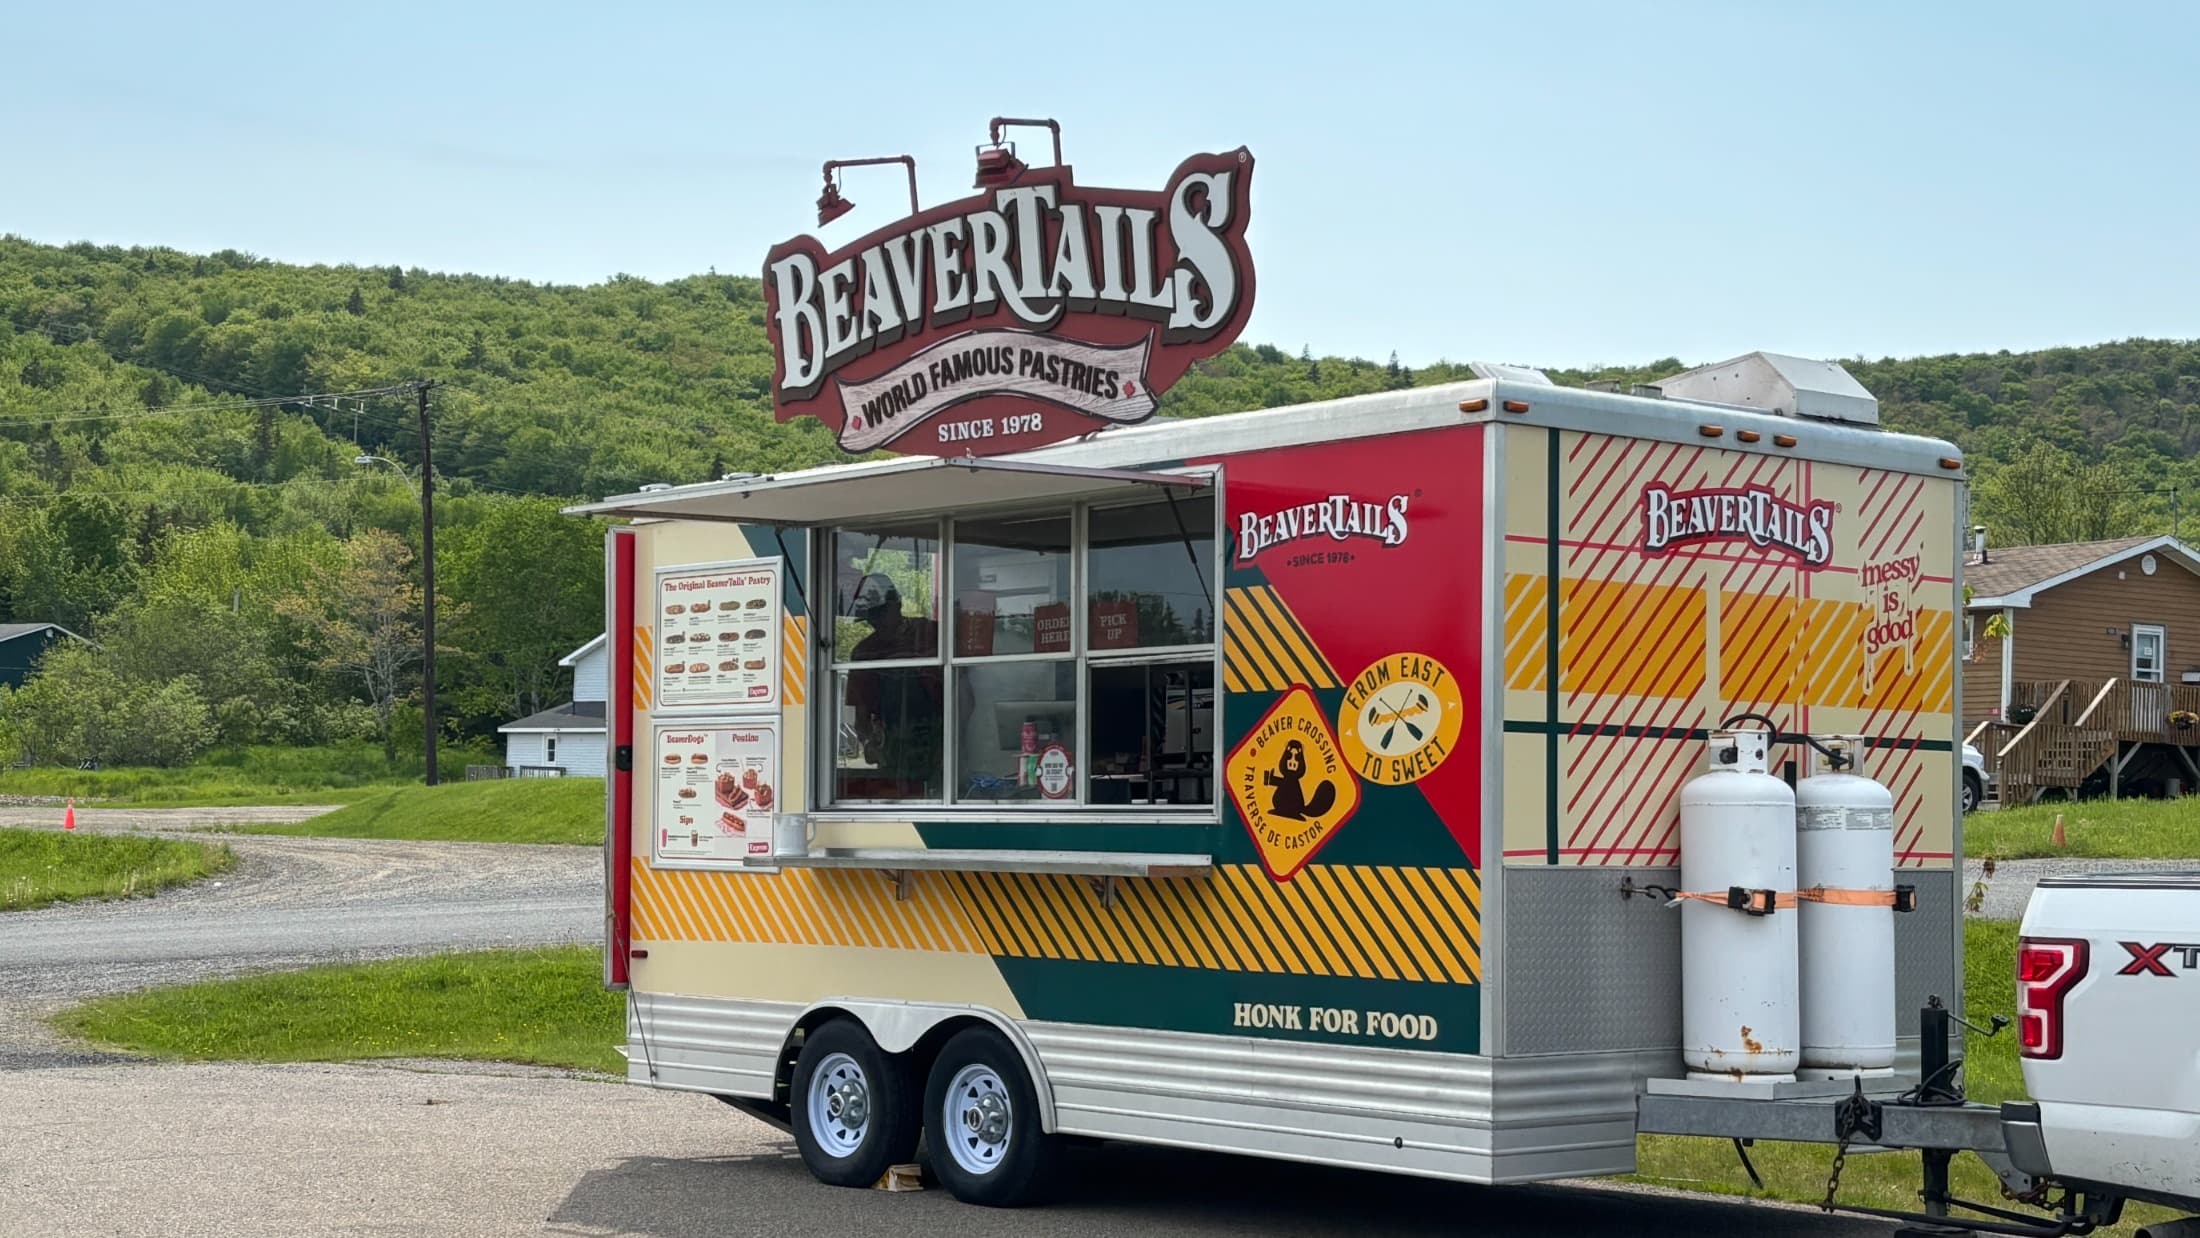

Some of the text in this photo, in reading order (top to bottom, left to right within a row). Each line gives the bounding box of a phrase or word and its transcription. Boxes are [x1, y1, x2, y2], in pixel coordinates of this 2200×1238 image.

[771, 171, 1236, 390] BEAVERTAILS
[861, 346, 1120, 428] WORLD FAMOUS PASTRIES
[938, 412, 1042, 442] SINCE 1978
[1239, 495, 1409, 560] BEAVERTAILS
[1647, 489, 1830, 565] BEAVERTAILS
[1292, 553, 1325, 567] SINCE
[1861, 552, 1920, 587] messy
[664, 583, 677, 592] The
[679, 580, 706, 592] Original
[749, 576, 771, 587] Pastry
[1882, 586, 1899, 613] is
[1099, 613, 1127, 627] PICK
[1107, 628, 1122, 641] UP
[1867, 610, 1914, 654] good
[1346, 656, 1445, 710] FROM EAST
[1256, 716, 1337, 774] BEAVER CROSSING
[1362, 736, 1446, 782] TO SWEET
[679, 815, 694, 826] Sips
[1244, 766, 1324, 850] TRAVERSE DE CASTOR
[1233, 1003, 1438, 1041] HONK FOR FOOD
